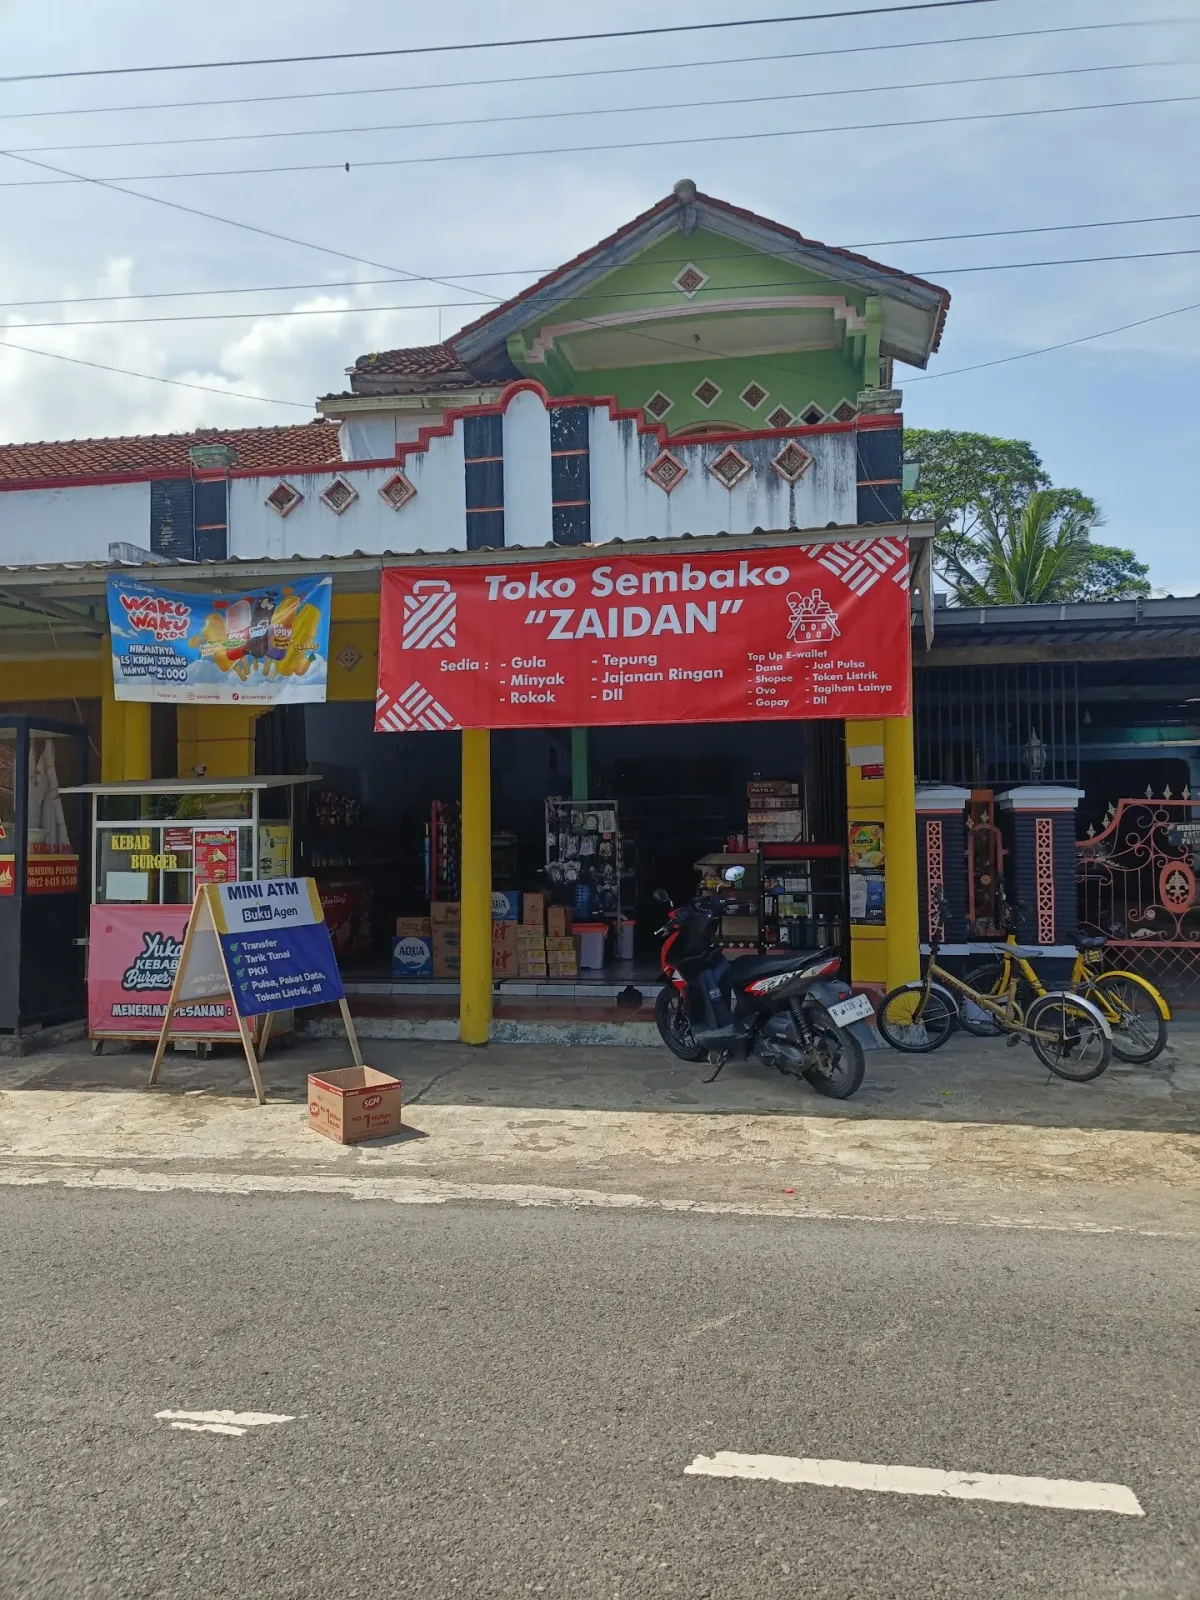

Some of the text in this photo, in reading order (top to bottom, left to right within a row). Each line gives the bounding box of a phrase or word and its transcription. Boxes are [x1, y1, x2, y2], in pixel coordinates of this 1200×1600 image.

[484, 561, 790, 600] Toko Sembako
[120, 595, 191, 617] WAKU
[128, 612, 190, 632] WAKU
[524, 599, 744, 640] "ZAIDAN"
[129, 645, 175, 656] NIKMATNYA
[747, 649, 828, 662] Top Up E-wallet
[120, 655, 187, 666] ES KRIM JEPANG
[440, 658, 480, 672] Sedia
[511, 655, 547, 669] Gula
[602, 653, 658, 668] Tepung
[812, 661, 834, 670] Jual
[837, 660, 865, 669] Pulsa
[123, 666, 146, 675] HANYA
[755, 664, 783, 673] Dana
[510, 672, 565, 688] Minyak
[602, 670, 664, 686] Jajanan
[668, 668, 724, 683] Ringan
[755, 675, 793, 684] Shopee
[812, 672, 843, 682] Token
[846, 671, 878, 681] Listrik
[602, 688, 623, 701] Dll
[755, 686, 776, 695] Ovo
[813, 684, 855, 695] Tagihan
[858, 683, 893, 694] Lainya
[510, 690, 556, 704] Rokok
[755, 698, 789, 708] Gopay
[813, 696, 828, 705] Dll
[111, 835, 151, 850] KEBAB
[131, 854, 177, 869] BURGER
[227, 881, 299, 901] MINI ATM
[243, 906, 298, 922] Buku Agen
[241, 939, 278, 951] Transfer
[245, 950, 291, 964] Tarik Tunai
[398, 946, 425, 958] AQUA
[135, 959, 179, 970] KEBAB
[248, 966, 268, 977] PKH
[123, 968, 171, 989] Burger
[251, 971, 326, 990] Pulsa, Paket Data,
[255, 984, 322, 1003] Token Listrik, dll
[364, 1095, 380, 1108] SGM
